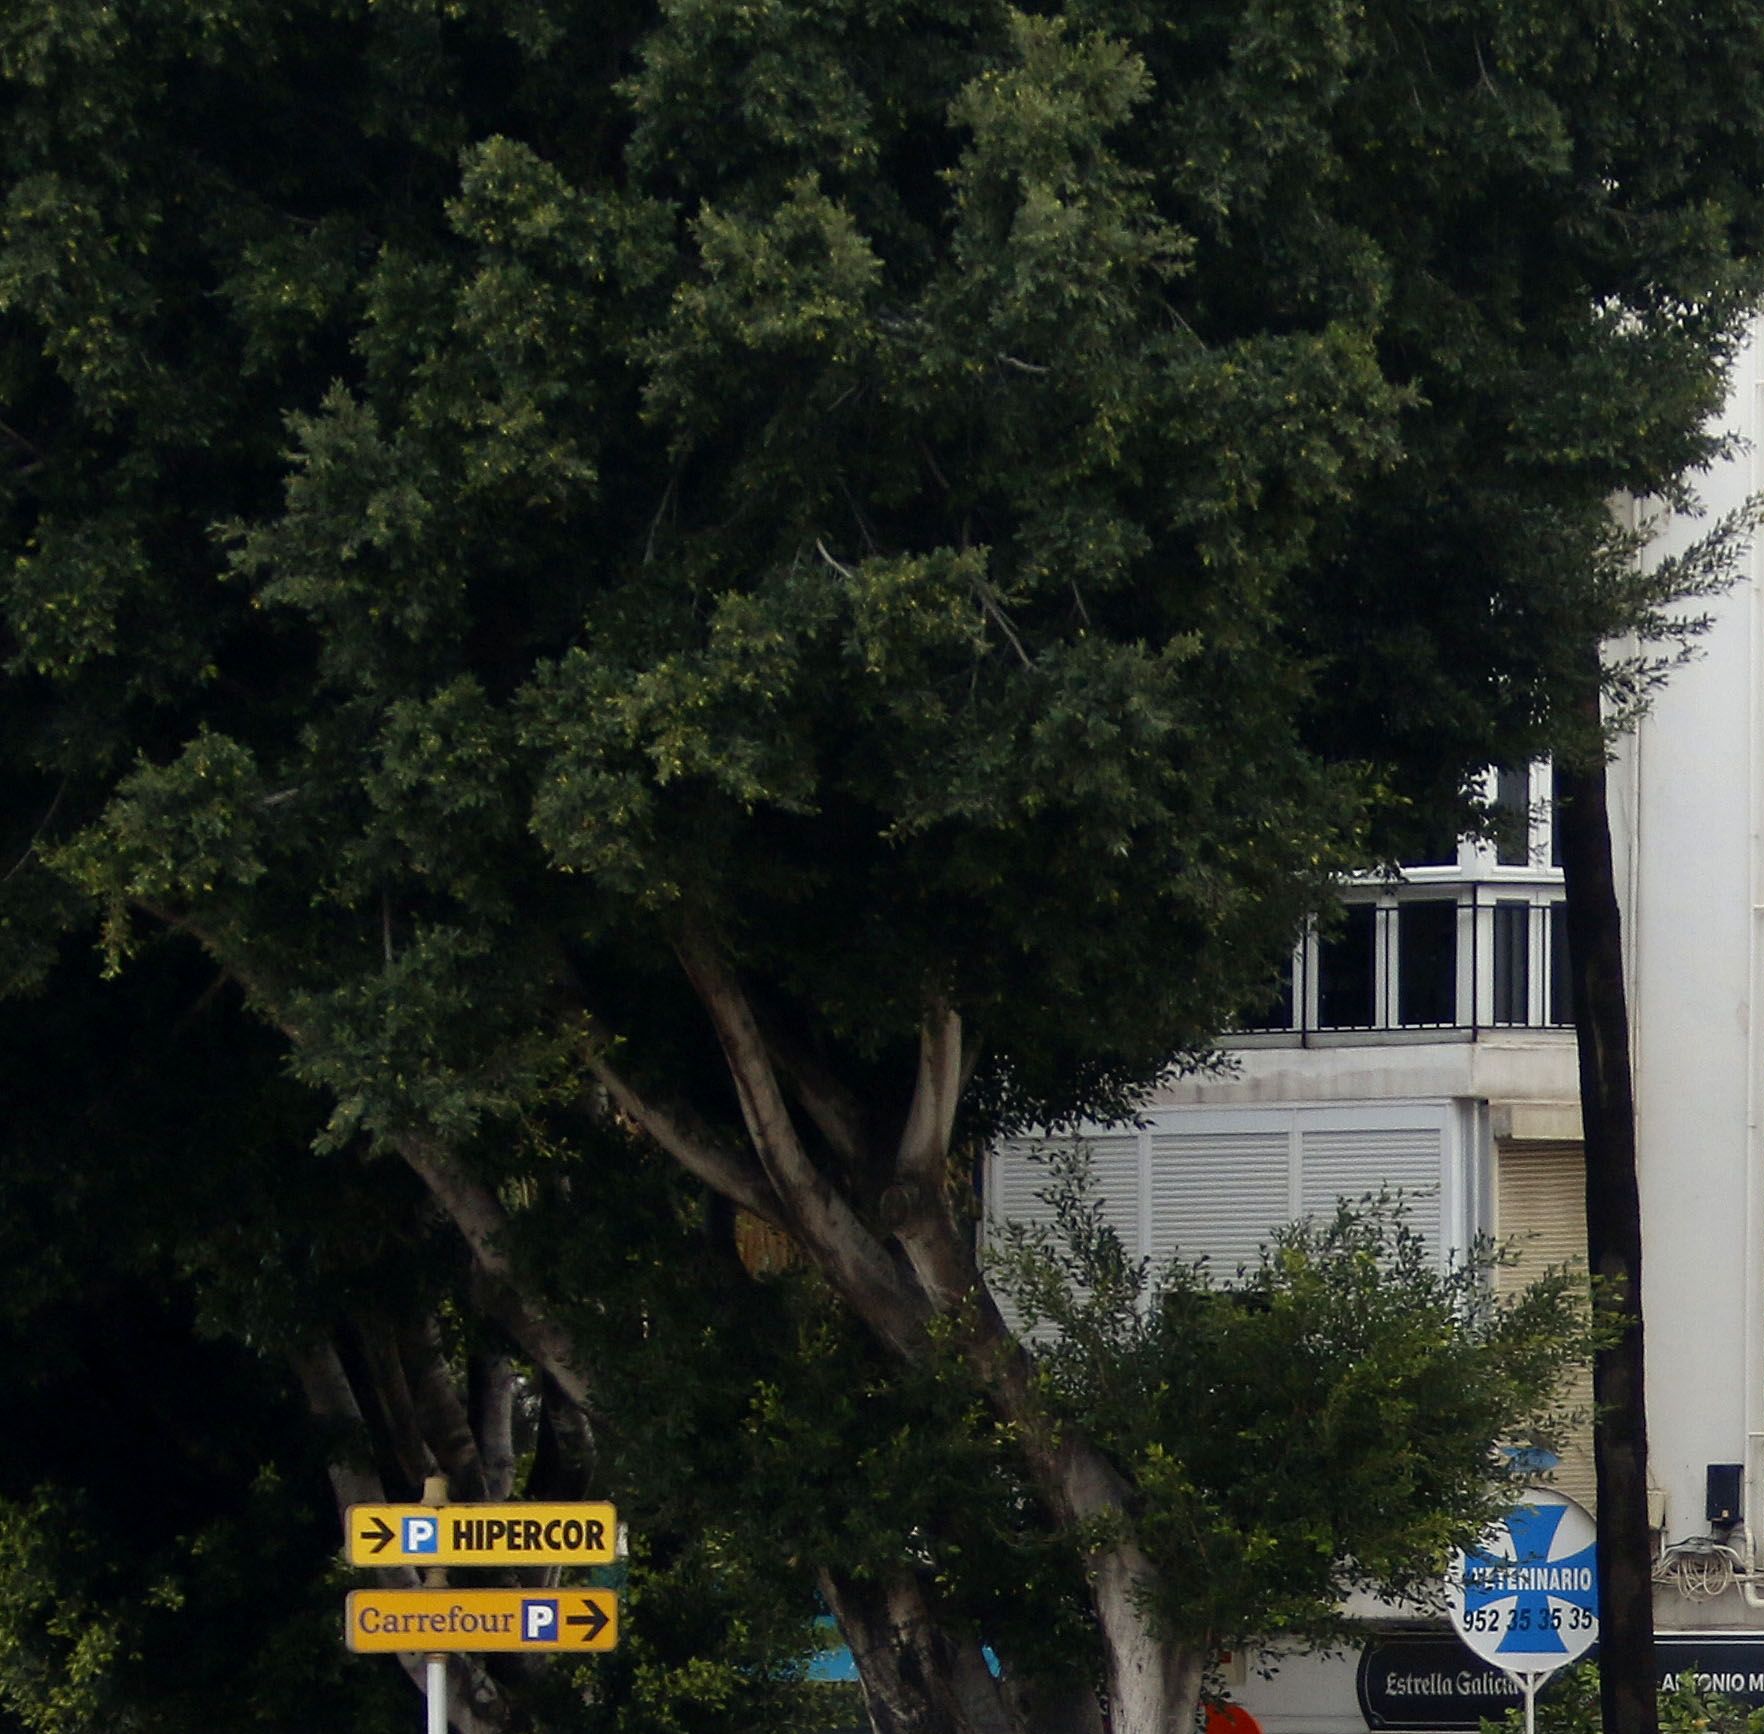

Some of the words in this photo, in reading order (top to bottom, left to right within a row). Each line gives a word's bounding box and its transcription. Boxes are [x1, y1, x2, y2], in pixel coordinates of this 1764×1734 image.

[408, 1519, 434, 1551] P
[453, 1519, 605, 1550] HIPERCOR
[1472, 1567, 1592, 1591] VETERINARIO
[359, 1606, 515, 1634] Carrefour
[527, 1605, 554, 1638] P
[1463, 1608, 1499, 1632] 952
[1507, 1607, 1531, 1631] 35
[1537, 1607, 1562, 1630] 35
[1569, 1607, 1593, 1630] 35
[1385, 1671, 1453, 1696] Estrella
[1455, 1670, 1519, 1696] Galicia
[1661, 1673, 1745, 1692] AONIO
